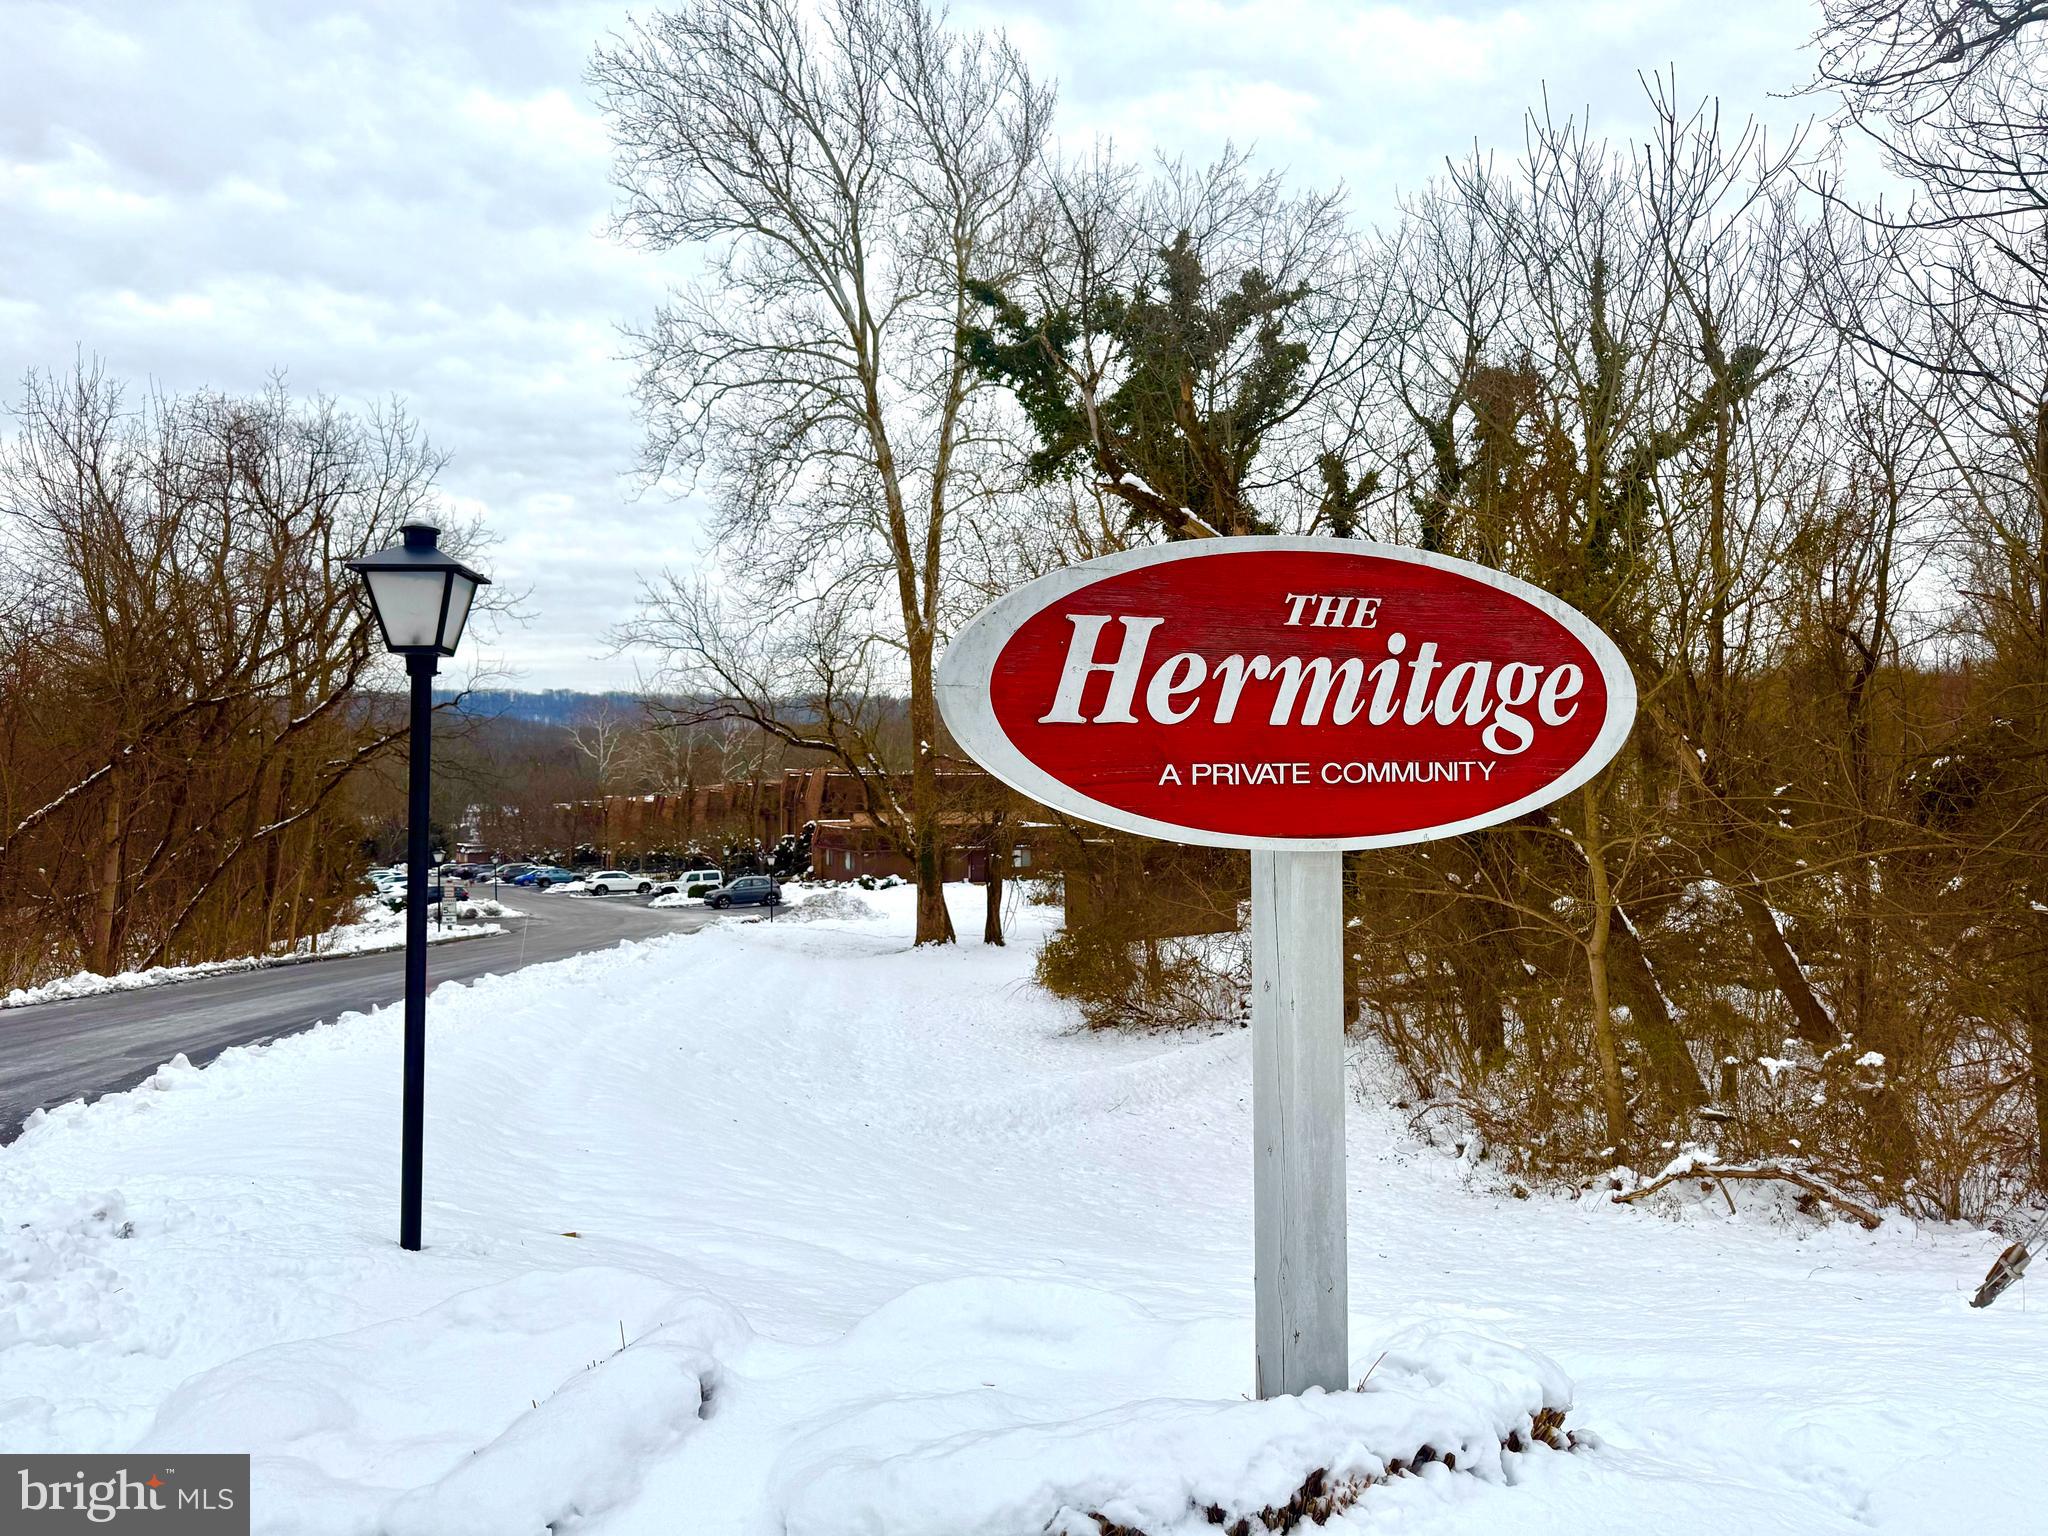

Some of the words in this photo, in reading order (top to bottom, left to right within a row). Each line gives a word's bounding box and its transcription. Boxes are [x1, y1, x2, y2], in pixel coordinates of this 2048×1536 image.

[1284, 592, 1382, 629] THE
[1038, 613, 1584, 755] Hermitage
[1158, 763, 1182, 786] A
[1192, 763, 1310, 786] PRIVATE
[1321, 760, 1496, 785] COMMUNITY
